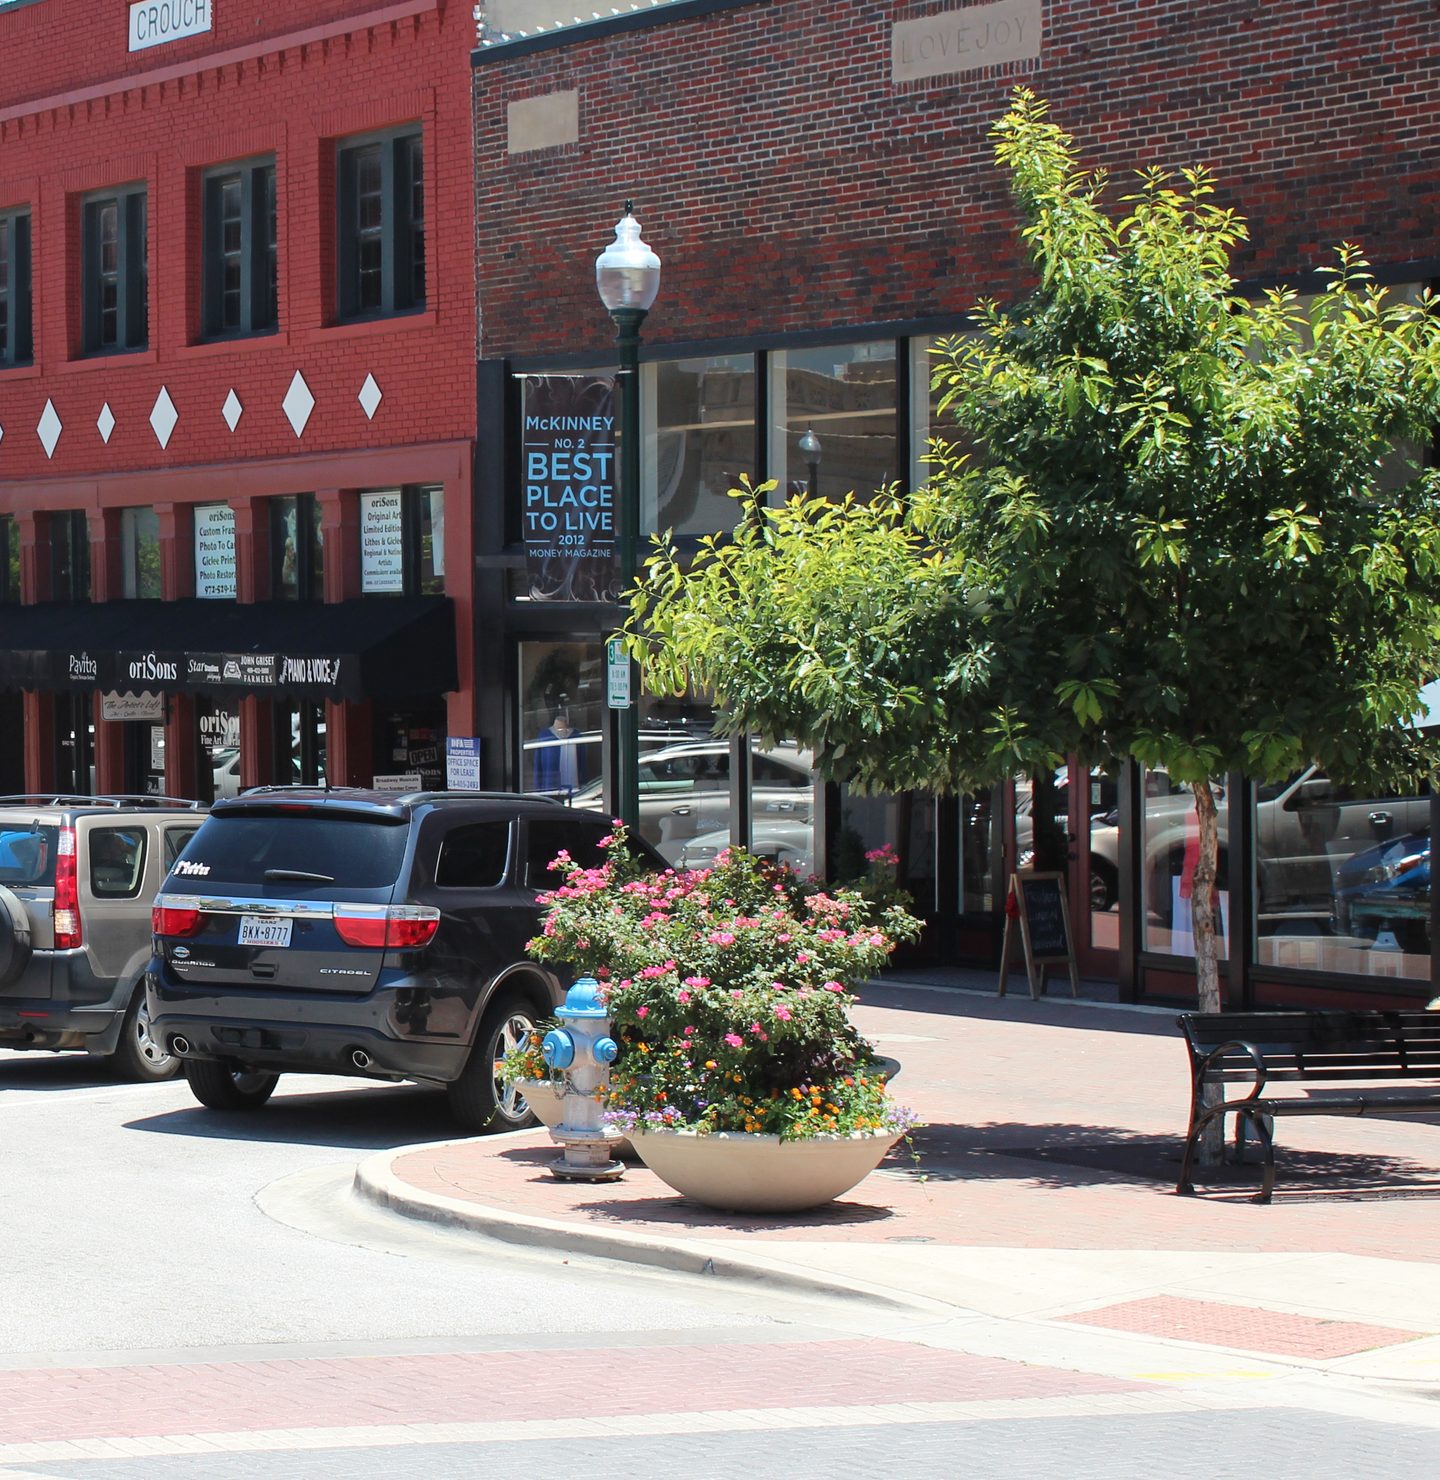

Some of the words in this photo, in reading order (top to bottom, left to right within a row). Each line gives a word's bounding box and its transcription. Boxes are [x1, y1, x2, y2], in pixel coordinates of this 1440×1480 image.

[137, 0, 205, 40] CROUCH
[902, 17, 1026, 64] LOVEJOY
[526, 416, 614, 430] McKINNEY
[555, 438, 574, 448] NO.
[577, 438, 584, 448] 2
[528, 452, 613, 481] BEST
[371, 496, 398, 508] oriSons
[527, 486, 613, 507] PLACE
[368, 510, 391, 523] Original
[526, 512, 558, 531] TO
[565, 512, 613, 530] LIVE
[200, 527, 220, 537] Custom
[363, 524, 384, 534] Limited
[200, 541, 217, 551] Photo
[218, 541, 225, 550] To
[558, 535, 585, 545] 2012
[529, 549, 561, 558] MONEY
[565, 549, 612, 558] MAGAZINE
[200, 571, 216, 580] Photo
[609, 645, 615, 659] 3
[69, 654, 97, 675] Pavitra
[129, 653, 177, 680] oriSons
[240, 656, 255, 665] JOHN
[288, 659, 306, 682] PIANO
[307, 659, 313, 682] &
[312, 659, 331, 683] VOICE
[243, 675, 273, 683] FARMERS
[201, 735, 212, 745] Fine
[320, 968, 372, 976] CITADEL
